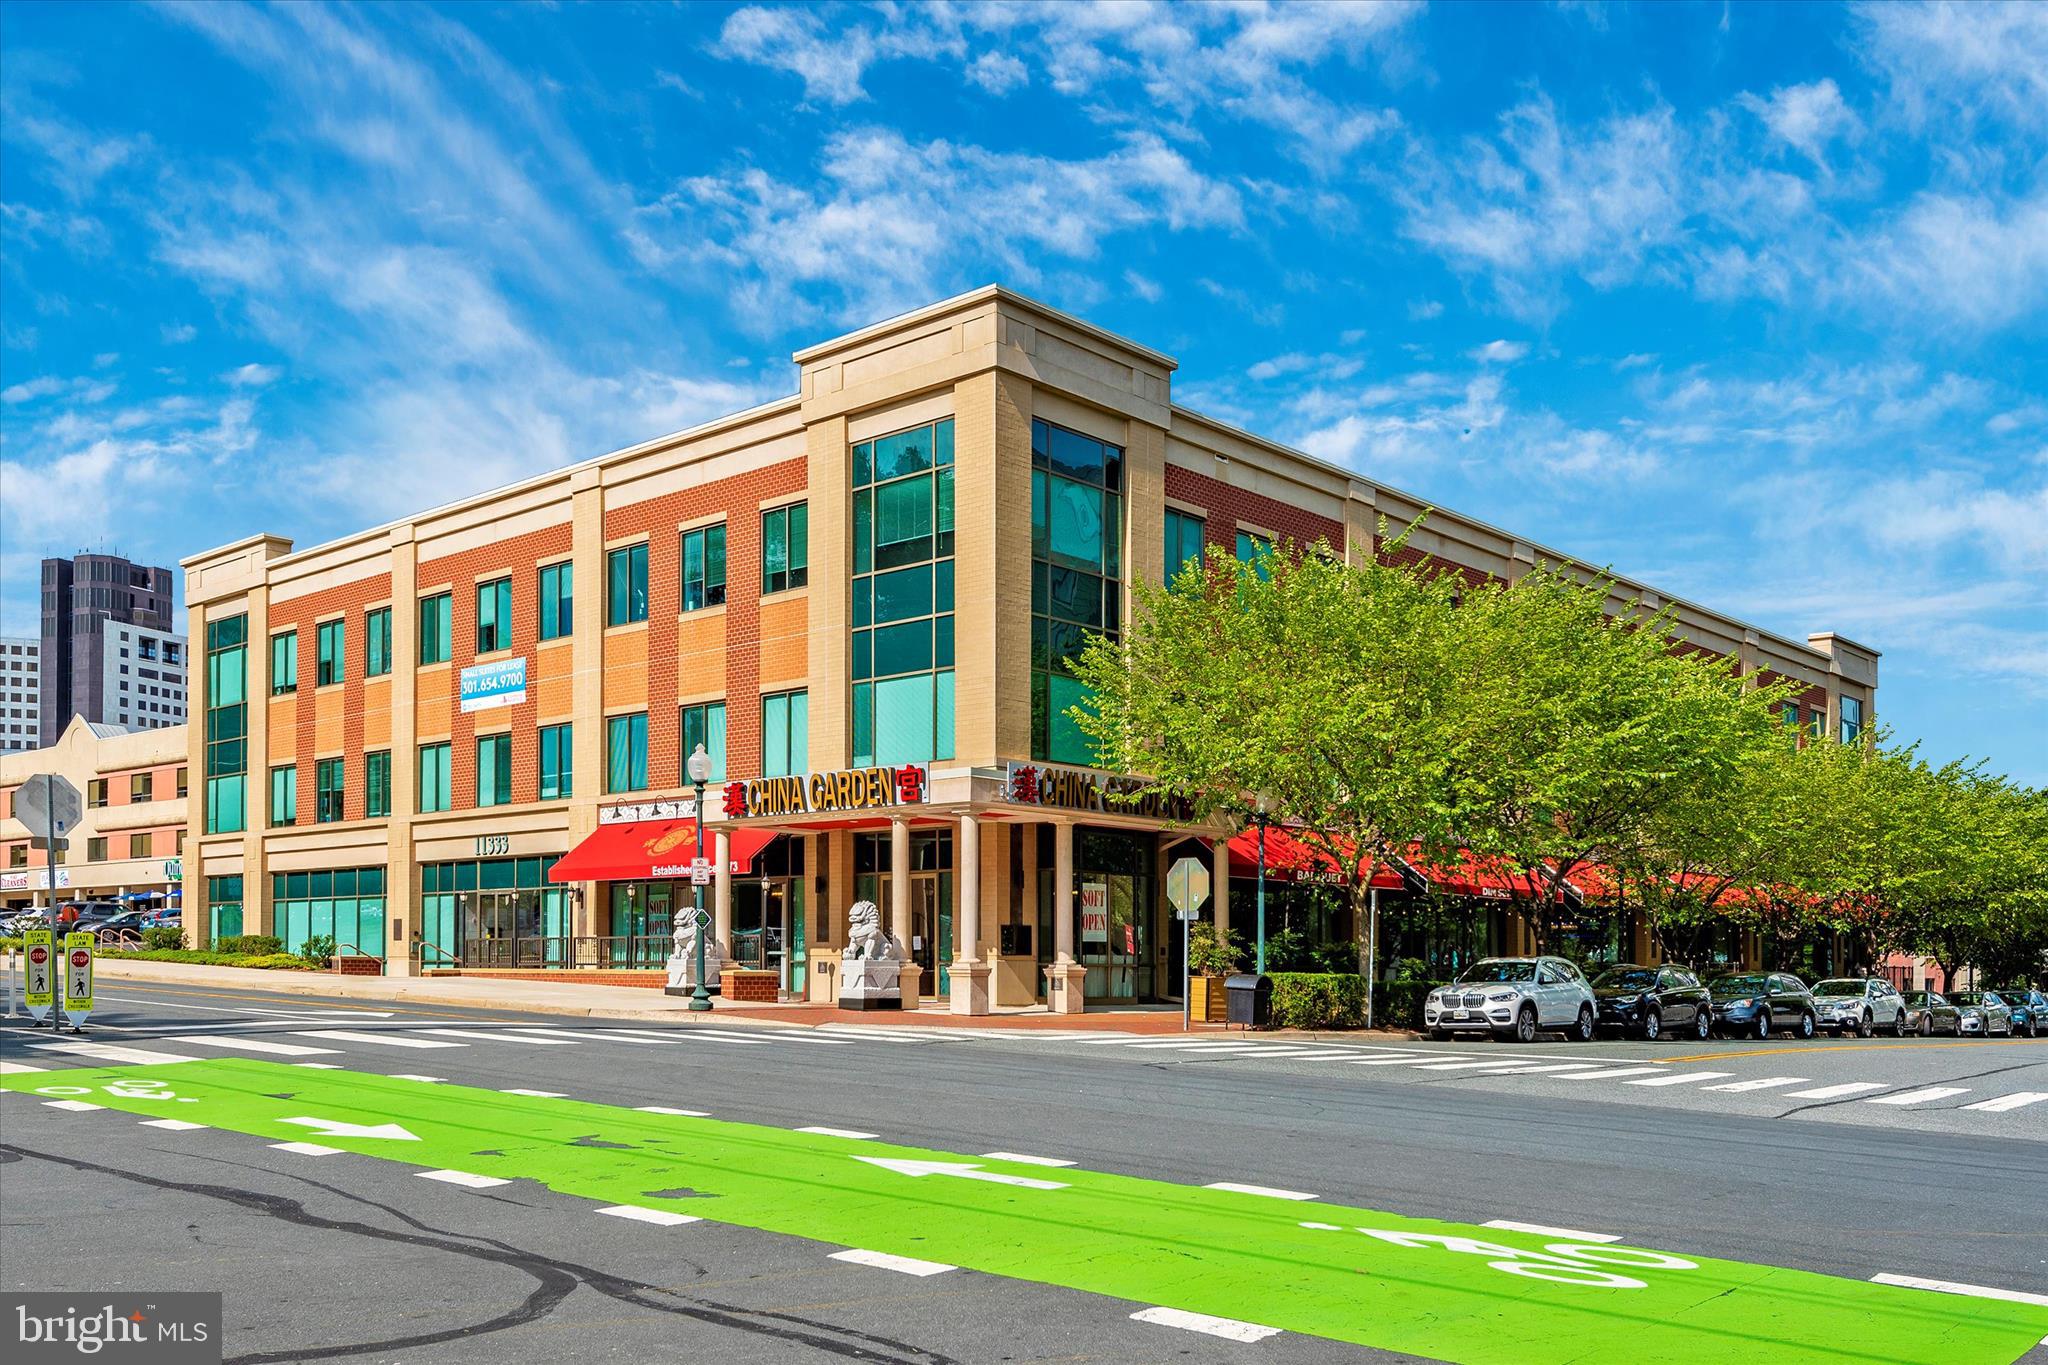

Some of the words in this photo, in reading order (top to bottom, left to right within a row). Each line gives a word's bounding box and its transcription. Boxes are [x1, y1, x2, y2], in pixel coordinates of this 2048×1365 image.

[462, 671, 523, 695] 301.654.9700
[748, 776, 804, 816] CHINA
[809, 767, 894, 811] GARDEN
[1041, 768, 1099, 810] CHINA
[475, 834, 509, 856] 11333
[1297, 870, 1342, 883] BAUET
[649, 900, 667, 914] SOFT
[1082, 890, 1105, 907] SOFT
[649, 920, 669, 935] OPEN
[1082, 914, 1105, 931] OPEN
[32, 952, 47, 960] STOP
